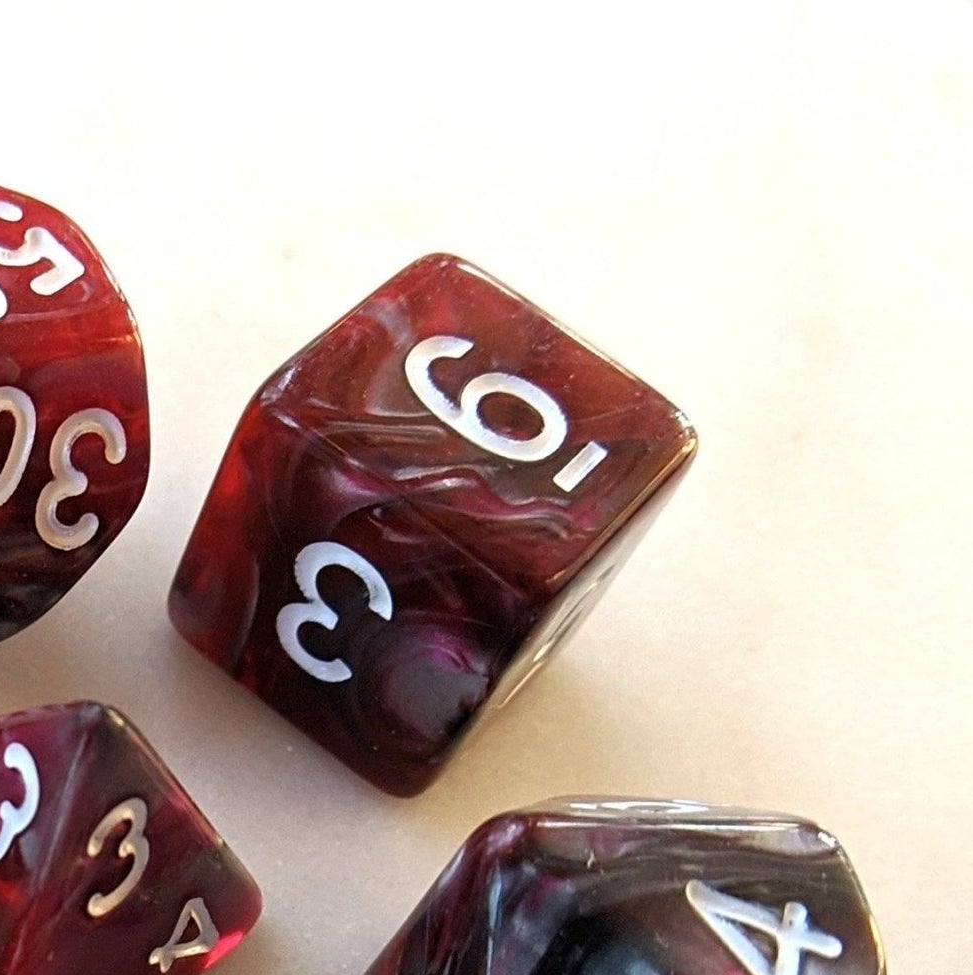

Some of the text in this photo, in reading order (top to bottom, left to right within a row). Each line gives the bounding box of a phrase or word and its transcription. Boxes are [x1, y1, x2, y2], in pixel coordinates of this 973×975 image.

[276, 540, 393, 683] 3
[86, 797, 150, 917] 3
[148, 897, 220, 973] 4
